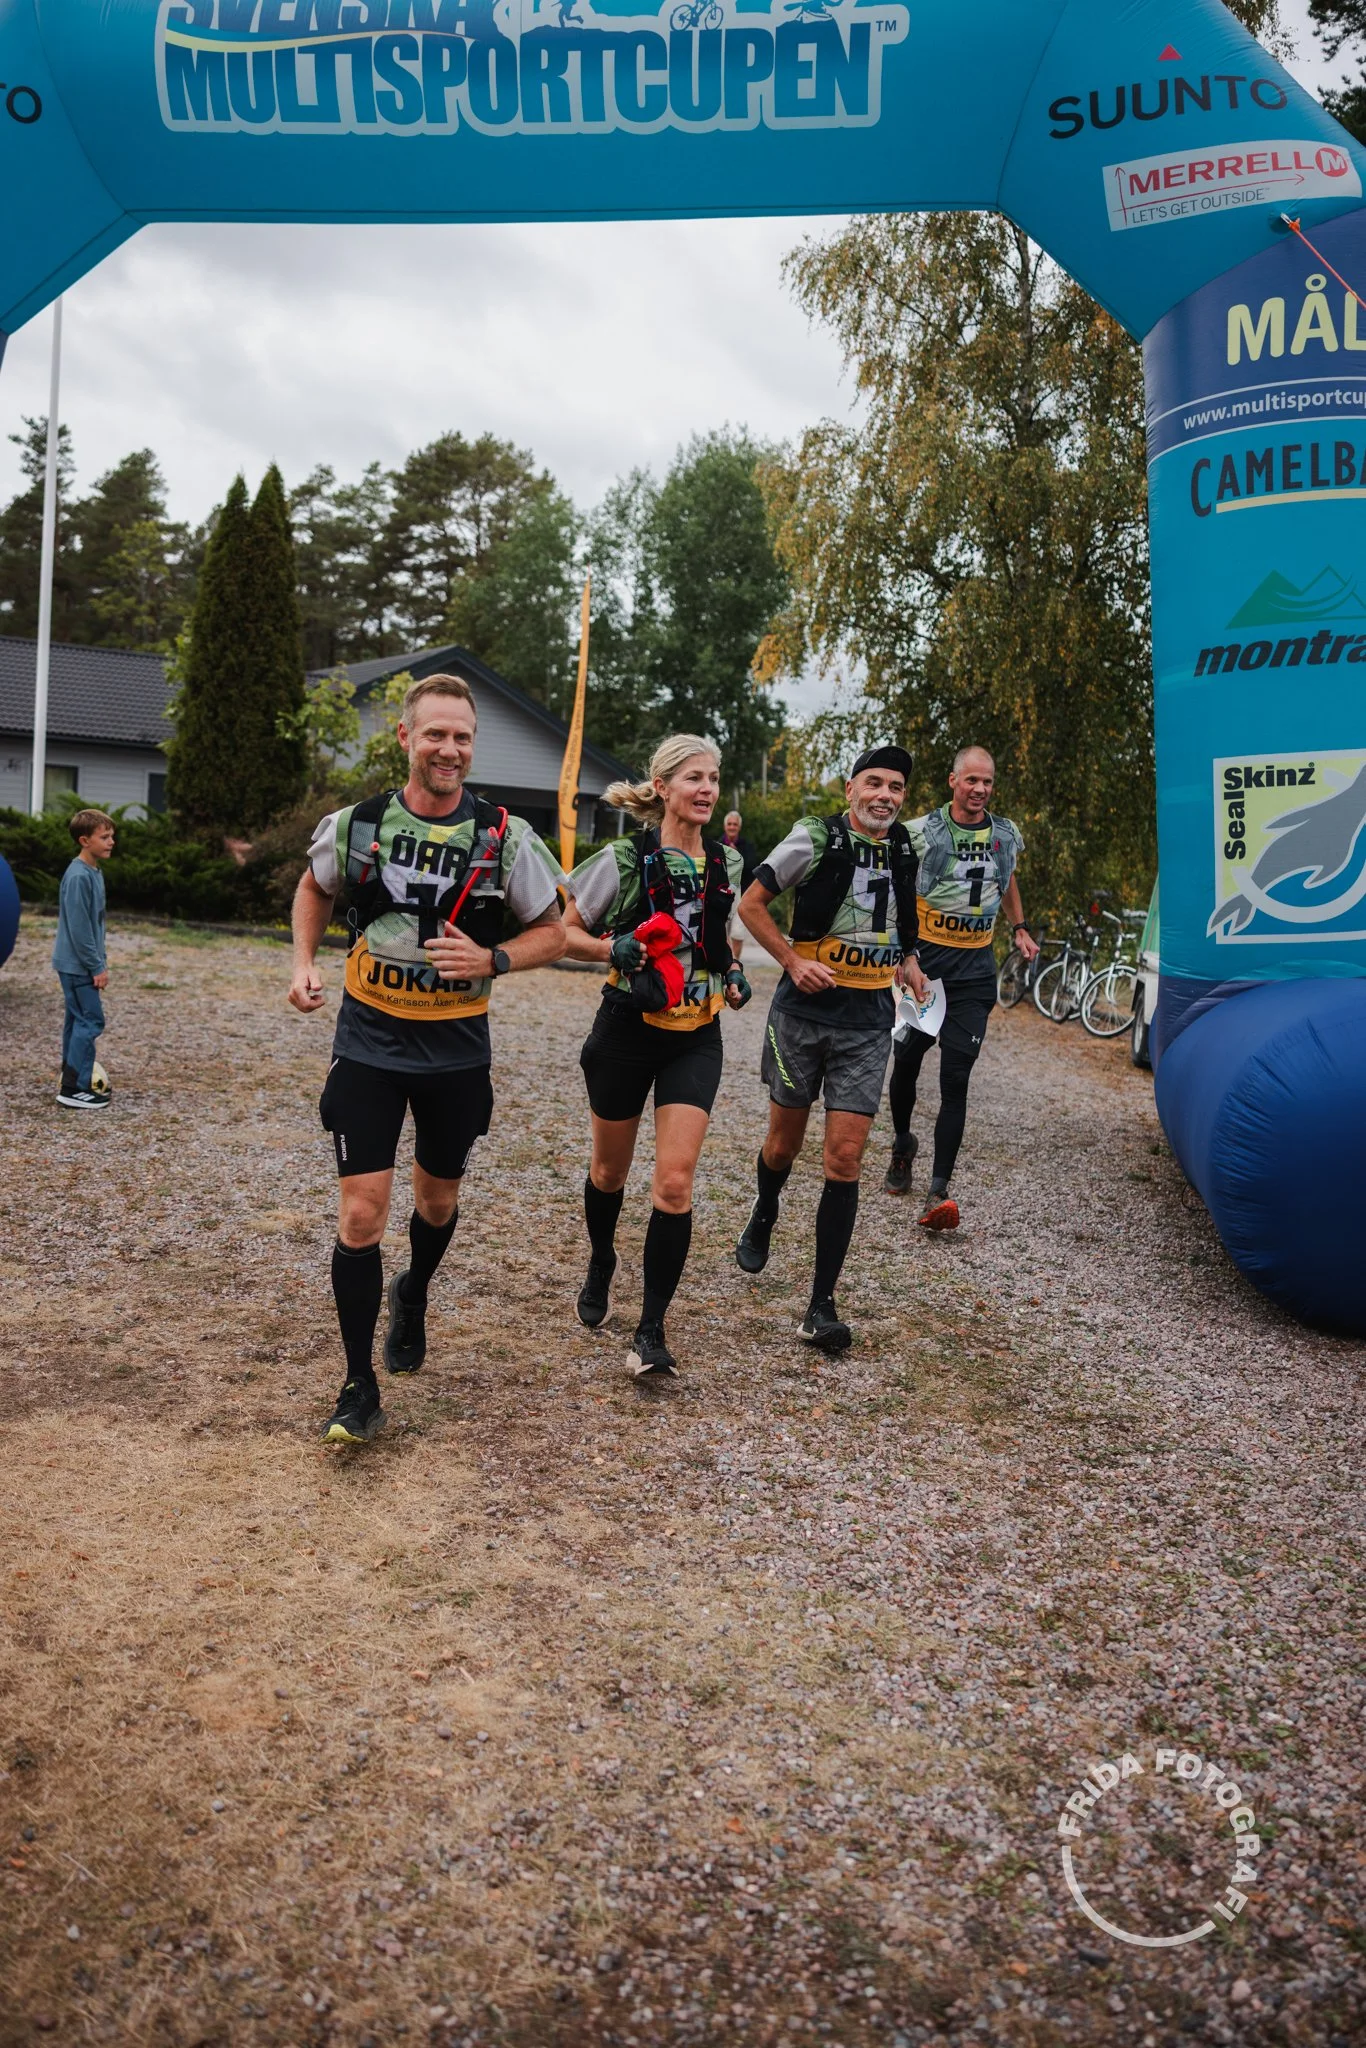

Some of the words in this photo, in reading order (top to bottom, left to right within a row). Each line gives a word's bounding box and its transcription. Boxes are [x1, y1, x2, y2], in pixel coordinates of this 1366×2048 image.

[165, 22, 871, 125] MULTISPORTCUPEN
[1048, 75, 1288, 140] SUUNTO
[1129, 151, 1315, 196] MERRELL
[1132, 206, 1168, 224] LET'S
[1170, 200, 1199, 216] GET
[1201, 188, 1265, 210] OUTSIDE
[1224, 791, 1246, 860] Seal
[866, 876, 889, 934] 1
[965, 866, 986, 907] 1
